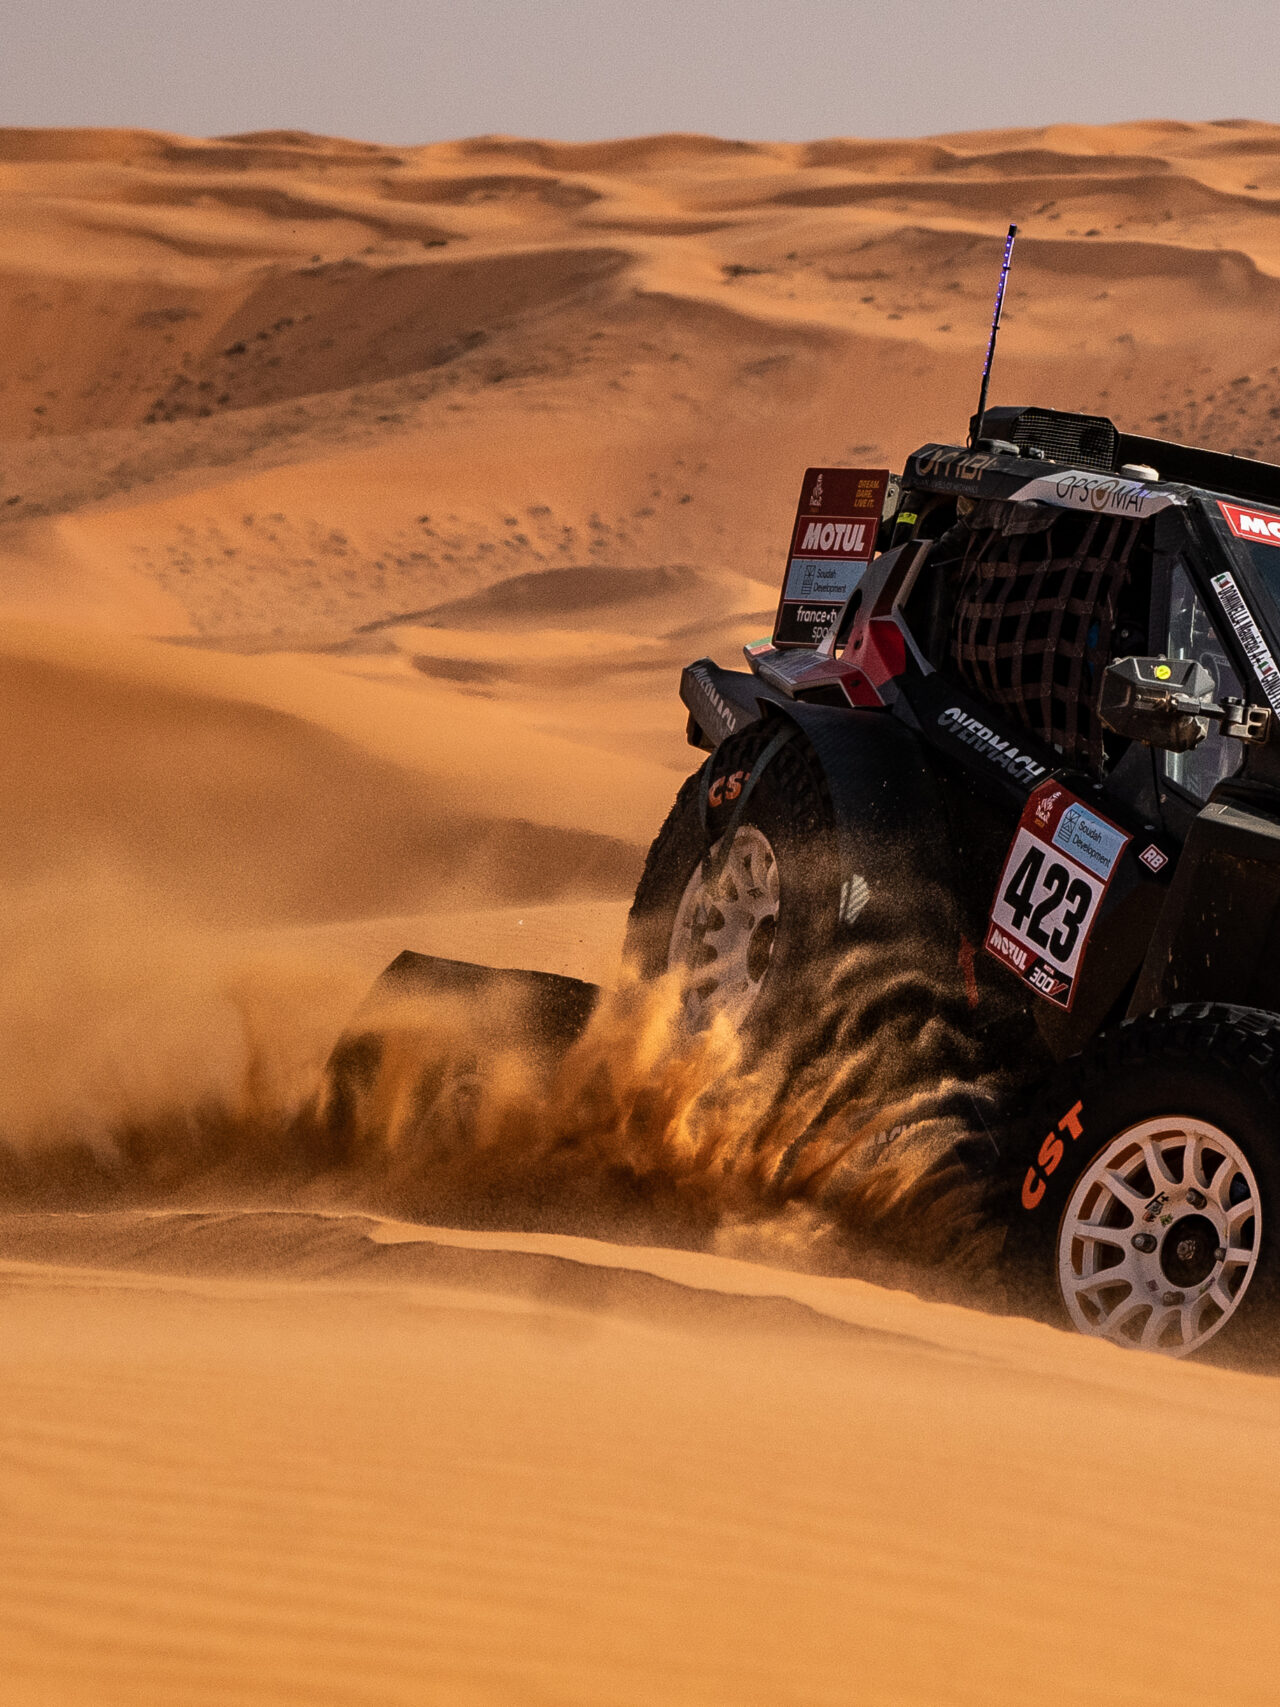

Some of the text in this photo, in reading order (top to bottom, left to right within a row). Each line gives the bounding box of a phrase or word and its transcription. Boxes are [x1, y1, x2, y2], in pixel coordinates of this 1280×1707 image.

[801, 522, 866, 552] MOTUL
[816, 568, 836, 579] Soudah
[938, 707, 1046, 784] OVERMACH
[708, 770, 752, 808] CS
[1079, 820, 1102, 844] Soudah
[1071, 834, 1111, 868] Development
[1143, 848, 1164, 868] RB
[1003, 845, 1093, 963] 423
[990, 929, 1028, 971] MOTUL
[1021, 1099, 1084, 1210] CST
